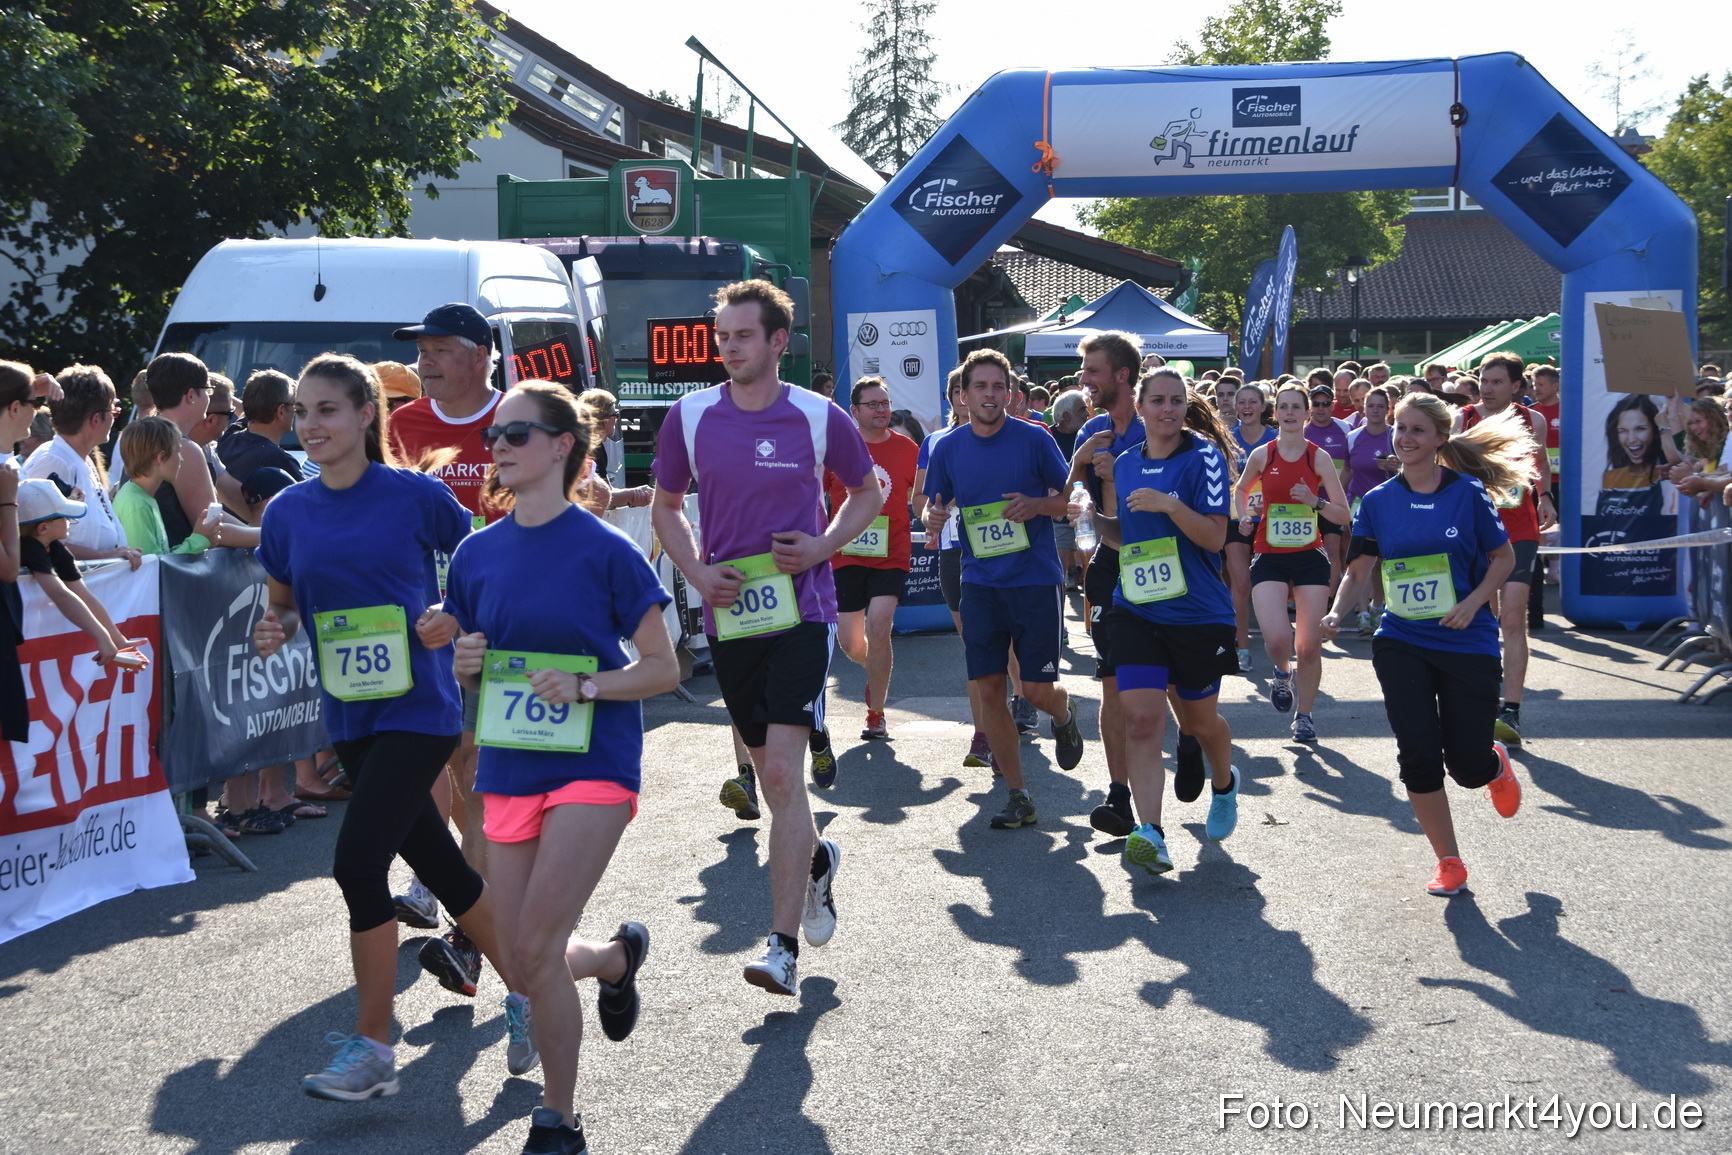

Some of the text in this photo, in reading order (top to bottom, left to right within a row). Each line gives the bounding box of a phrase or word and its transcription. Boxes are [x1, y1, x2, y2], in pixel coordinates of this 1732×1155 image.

[1247, 101, 1297, 113] Fischer
[1207, 124, 1360, 156] firmenlauf
[1207, 156, 1270, 167] neumarkt
[1520, 171, 1543, 184] und
[1546, 168, 1568, 179] das
[924, 191, 1004, 208] Fischer
[931, 207, 997, 216] AUTOMOBILE
[640, 218, 664, 227] 1628
[905, 361, 919, 373] FIAT
[754, 460, 799, 469] Fertigteilwerke
[1141, 466, 1164, 475] hummel
[1410, 502, 1435, 510] hummel
[977, 521, 1014, 543] 784
[1272, 521, 1312, 536] 1385
[1134, 562, 1171, 587] 819
[1397, 580, 1439, 604] 767
[739, 617, 760, 626] Matthias
[336, 643, 391, 677] 758
[362, 679, 384, 687] Mederer
[503, 690, 570, 725] 769
[246, 697, 321, 740] AUTOMOBILE
[512, 727, 555, 737] Larissa März
